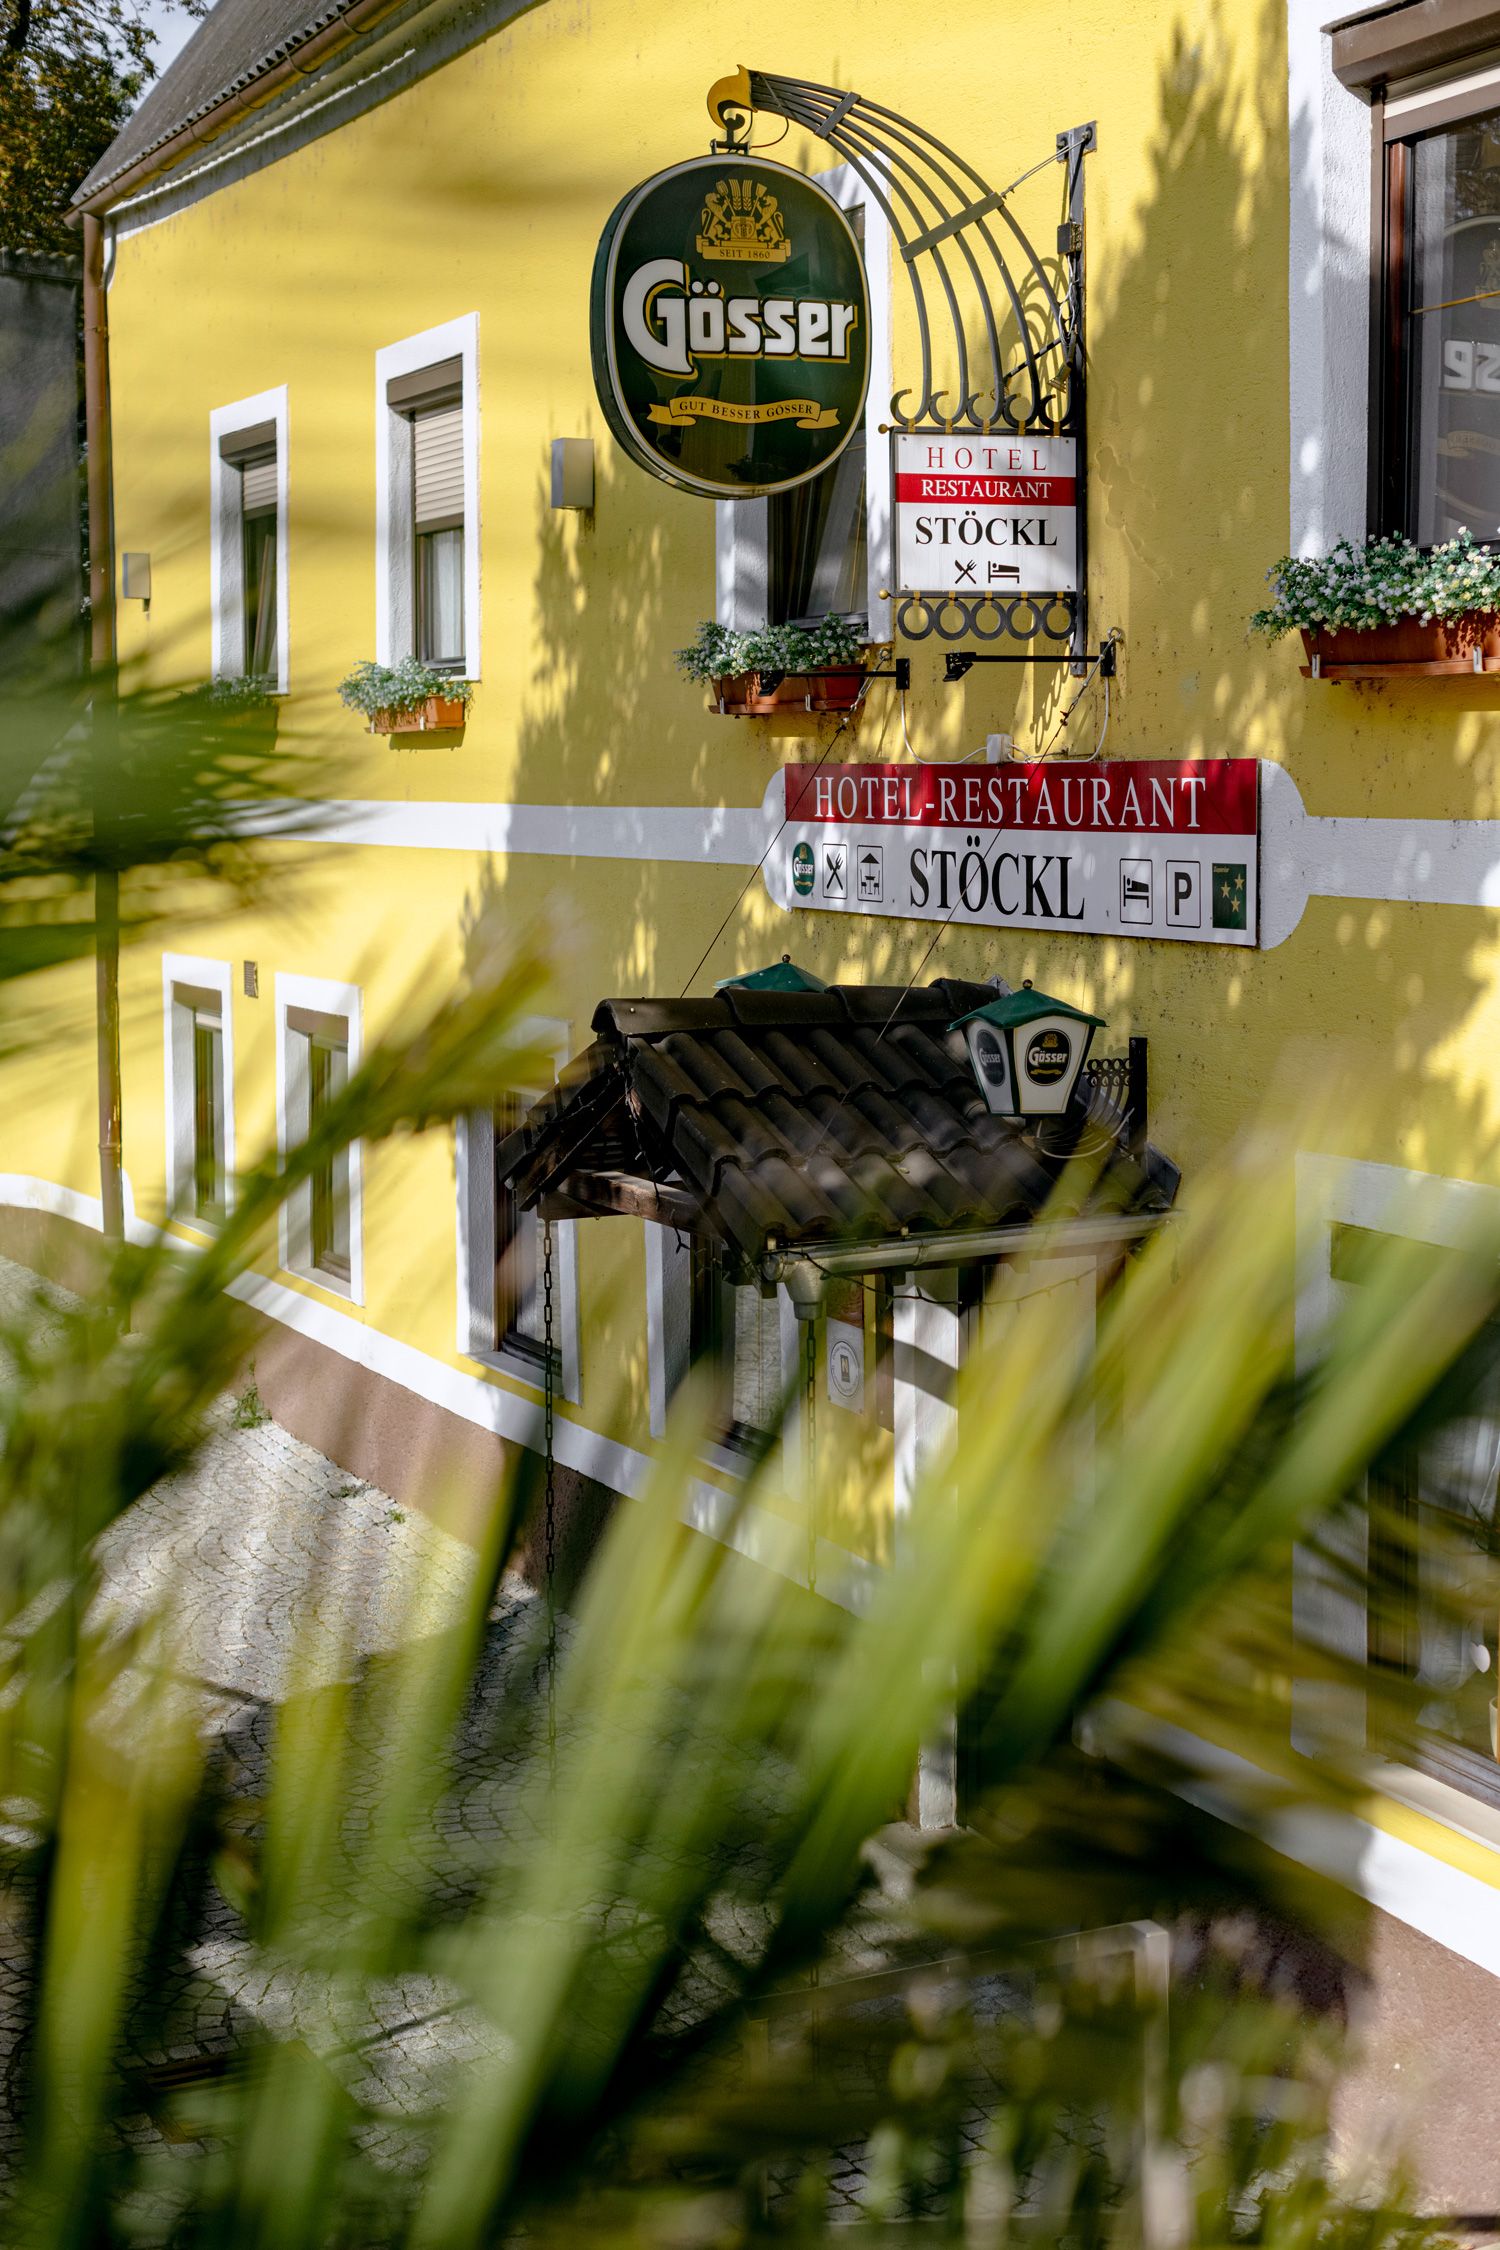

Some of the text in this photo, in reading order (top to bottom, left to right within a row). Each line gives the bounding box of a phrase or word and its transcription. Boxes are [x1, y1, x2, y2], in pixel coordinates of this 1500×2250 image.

[719, 248, 771, 260] SEIT 1860
[622, 258, 857, 379] Gösser
[679, 400, 813, 419] GUT BESSER GÖSSER
[927, 447, 1047, 470] HOTEL
[921, 479, 1052, 499] RESTAURANT
[915, 510, 1058, 546] STÖCKL
[814, 776, 1206, 828] HOTEL-RESTAURANT
[910, 834, 1085, 920] STÖCKL
[1174, 871, 1192, 916] P
[1028, 1047, 1067, 1066] Gösser
